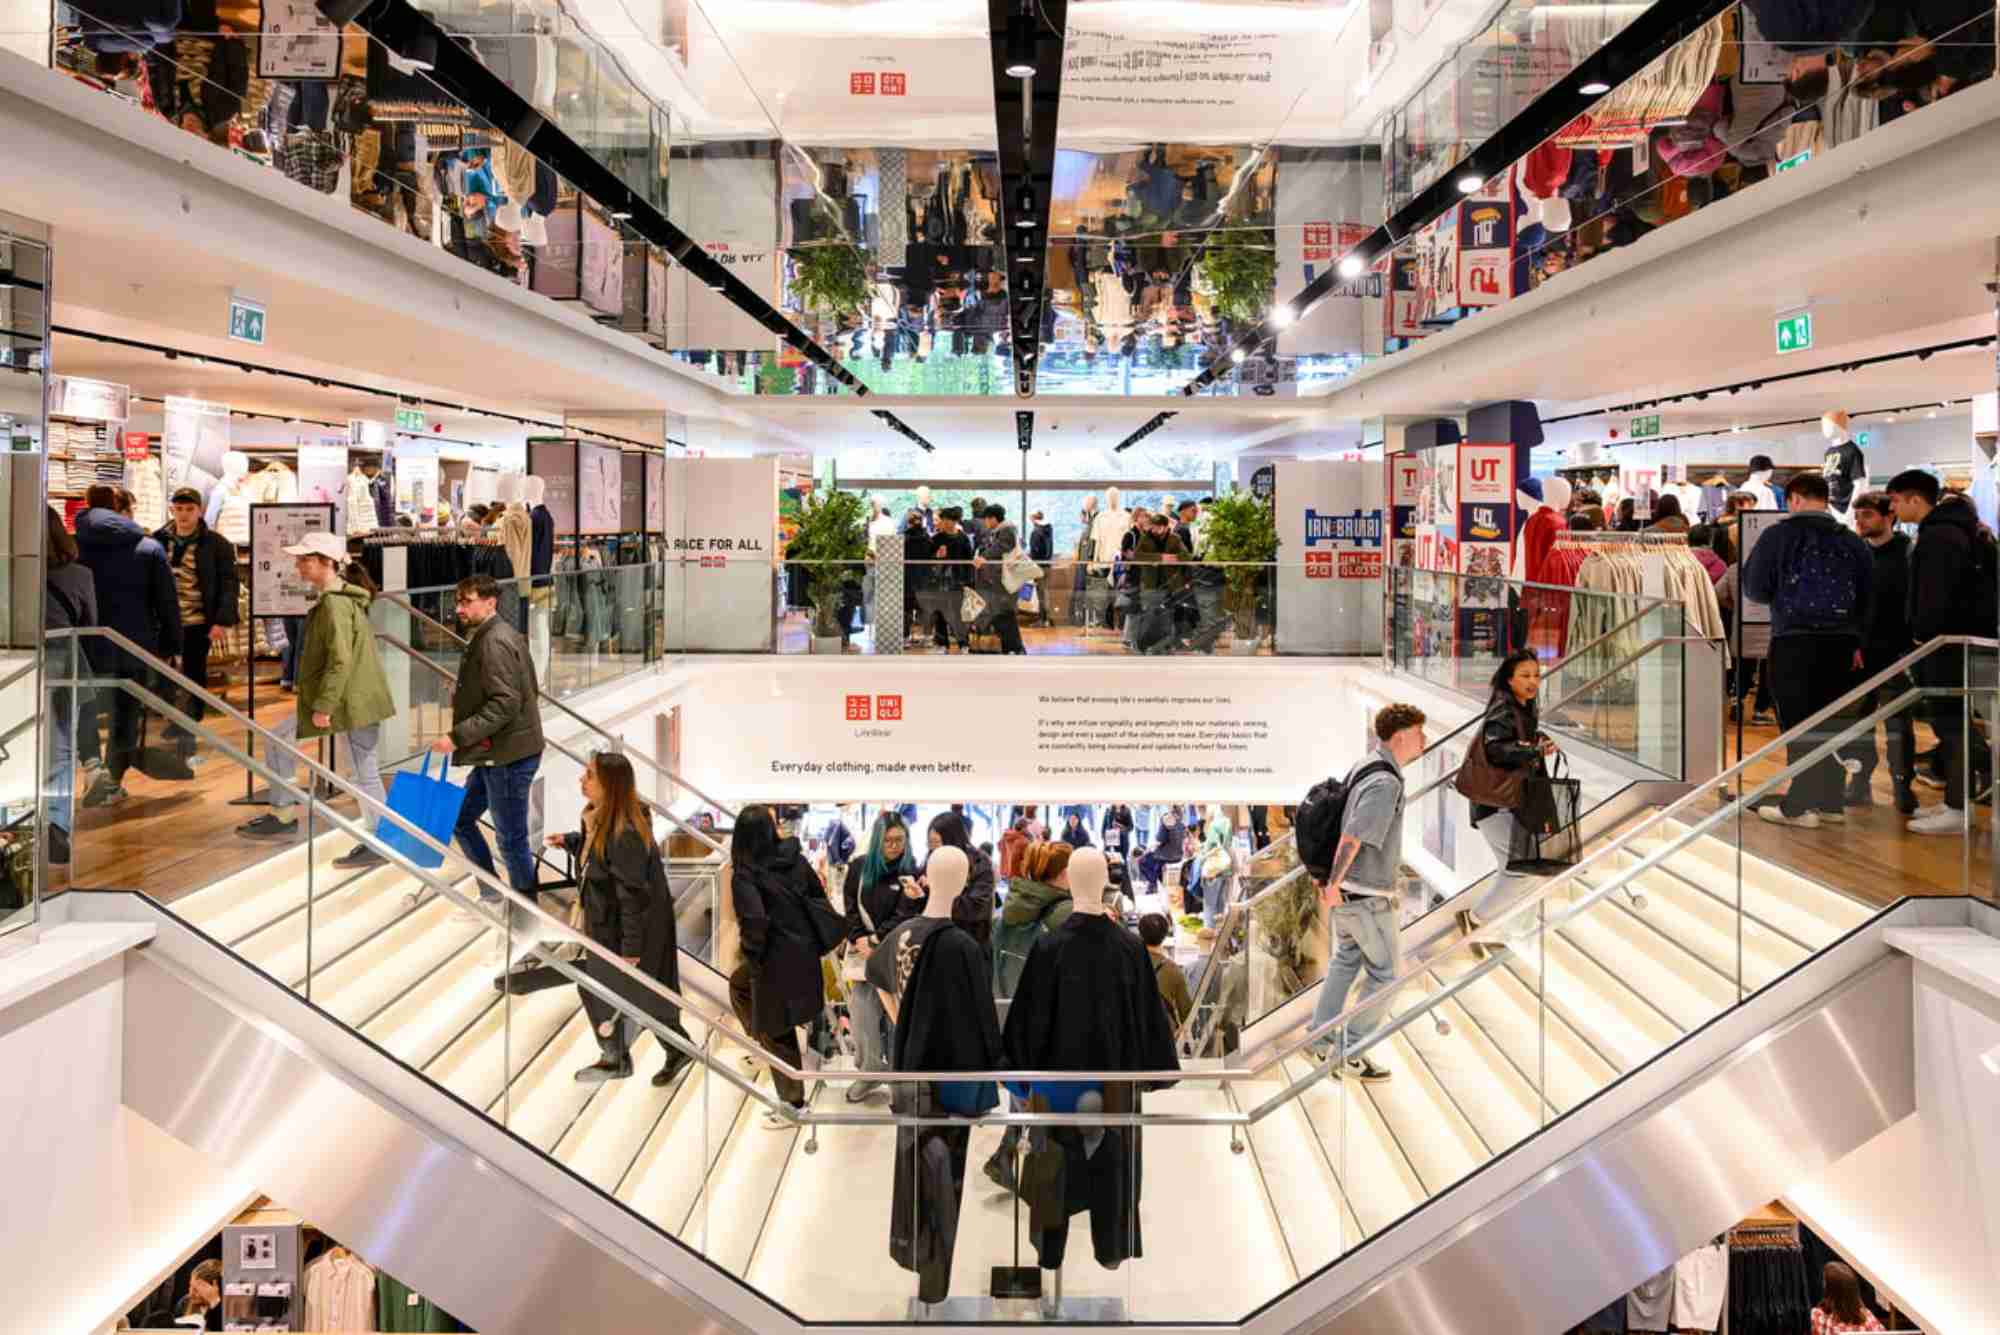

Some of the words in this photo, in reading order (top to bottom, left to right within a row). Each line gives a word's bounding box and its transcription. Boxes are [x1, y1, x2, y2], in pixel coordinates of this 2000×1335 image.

[1471, 458, 1500, 481] UT
[673, 538, 705, 551] RACE
[709, 538, 733, 551] FOR
[737, 538, 762, 551] ALL
[770, 759, 823, 776] Everyday
[825, 760, 875, 776] clothing,
[876, 760, 907, 773] made
[909, 762, 936, 773] even
[937, 760, 976, 774] better.
